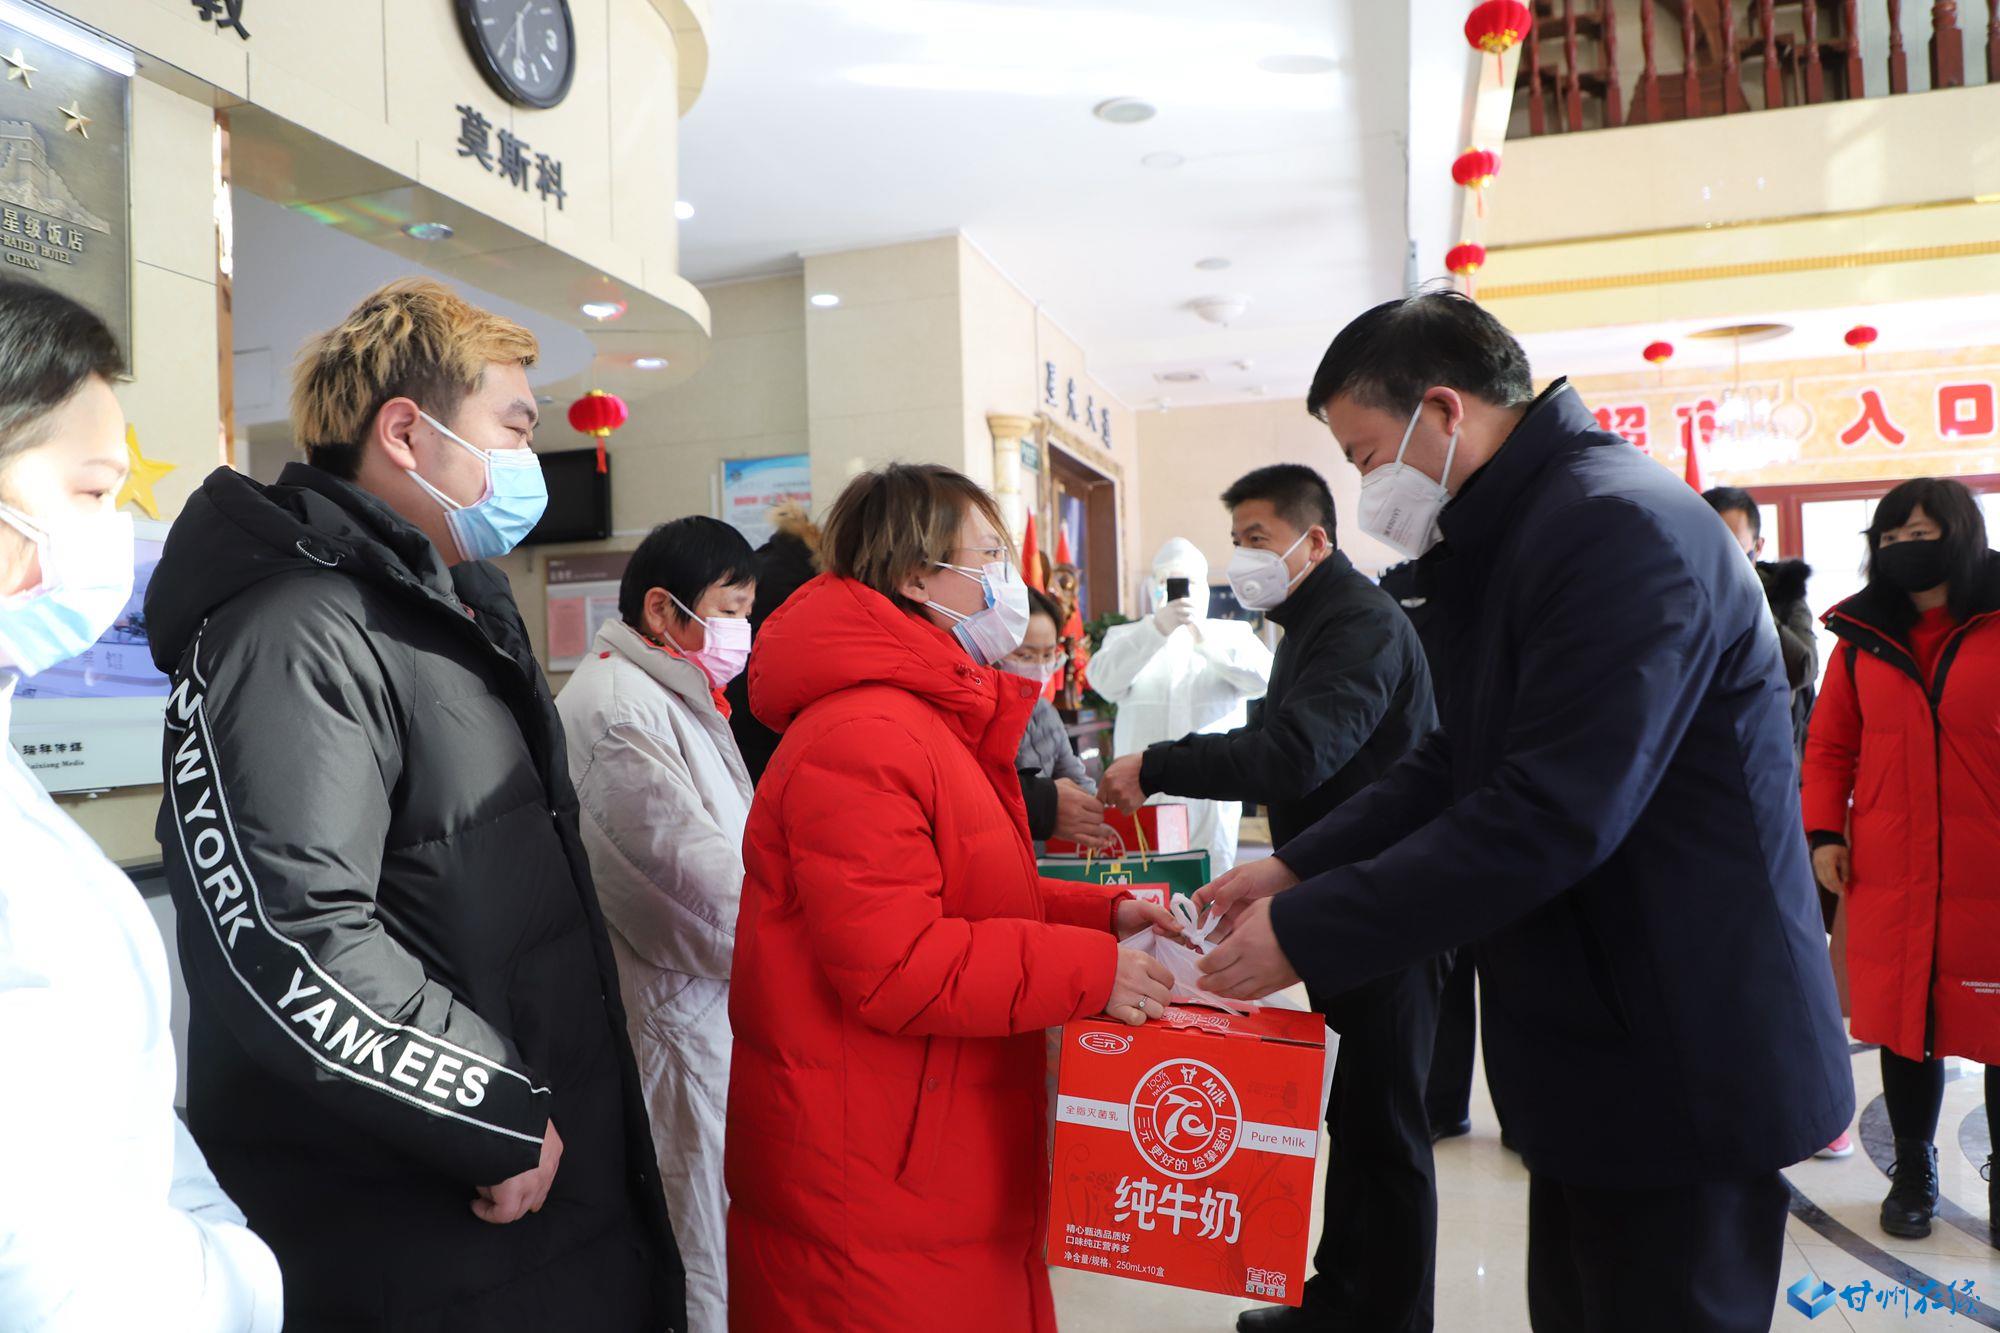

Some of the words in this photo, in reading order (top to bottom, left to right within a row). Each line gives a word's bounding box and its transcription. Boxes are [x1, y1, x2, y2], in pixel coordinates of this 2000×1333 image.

[546, 29, 557, 52] 3
[456, 104, 567, 211] 莫斯科
[1, 207, 84, 253] 星级饭店
[6, 252, 40, 270] CHINA
[1841, 383, 1993, 445] 入口
[184, 786, 256, 951] YORK
[276, 966, 490, 1108] YANKEES
[1092, 1038, 1116, 1049] 三元
[1202, 1078, 1227, 1107] Milk
[1251, 1131, 1278, 1144] Pure
[1282, 1135, 1305, 1148] Milk
[1114, 1175, 1242, 1244] 纯牛奶
